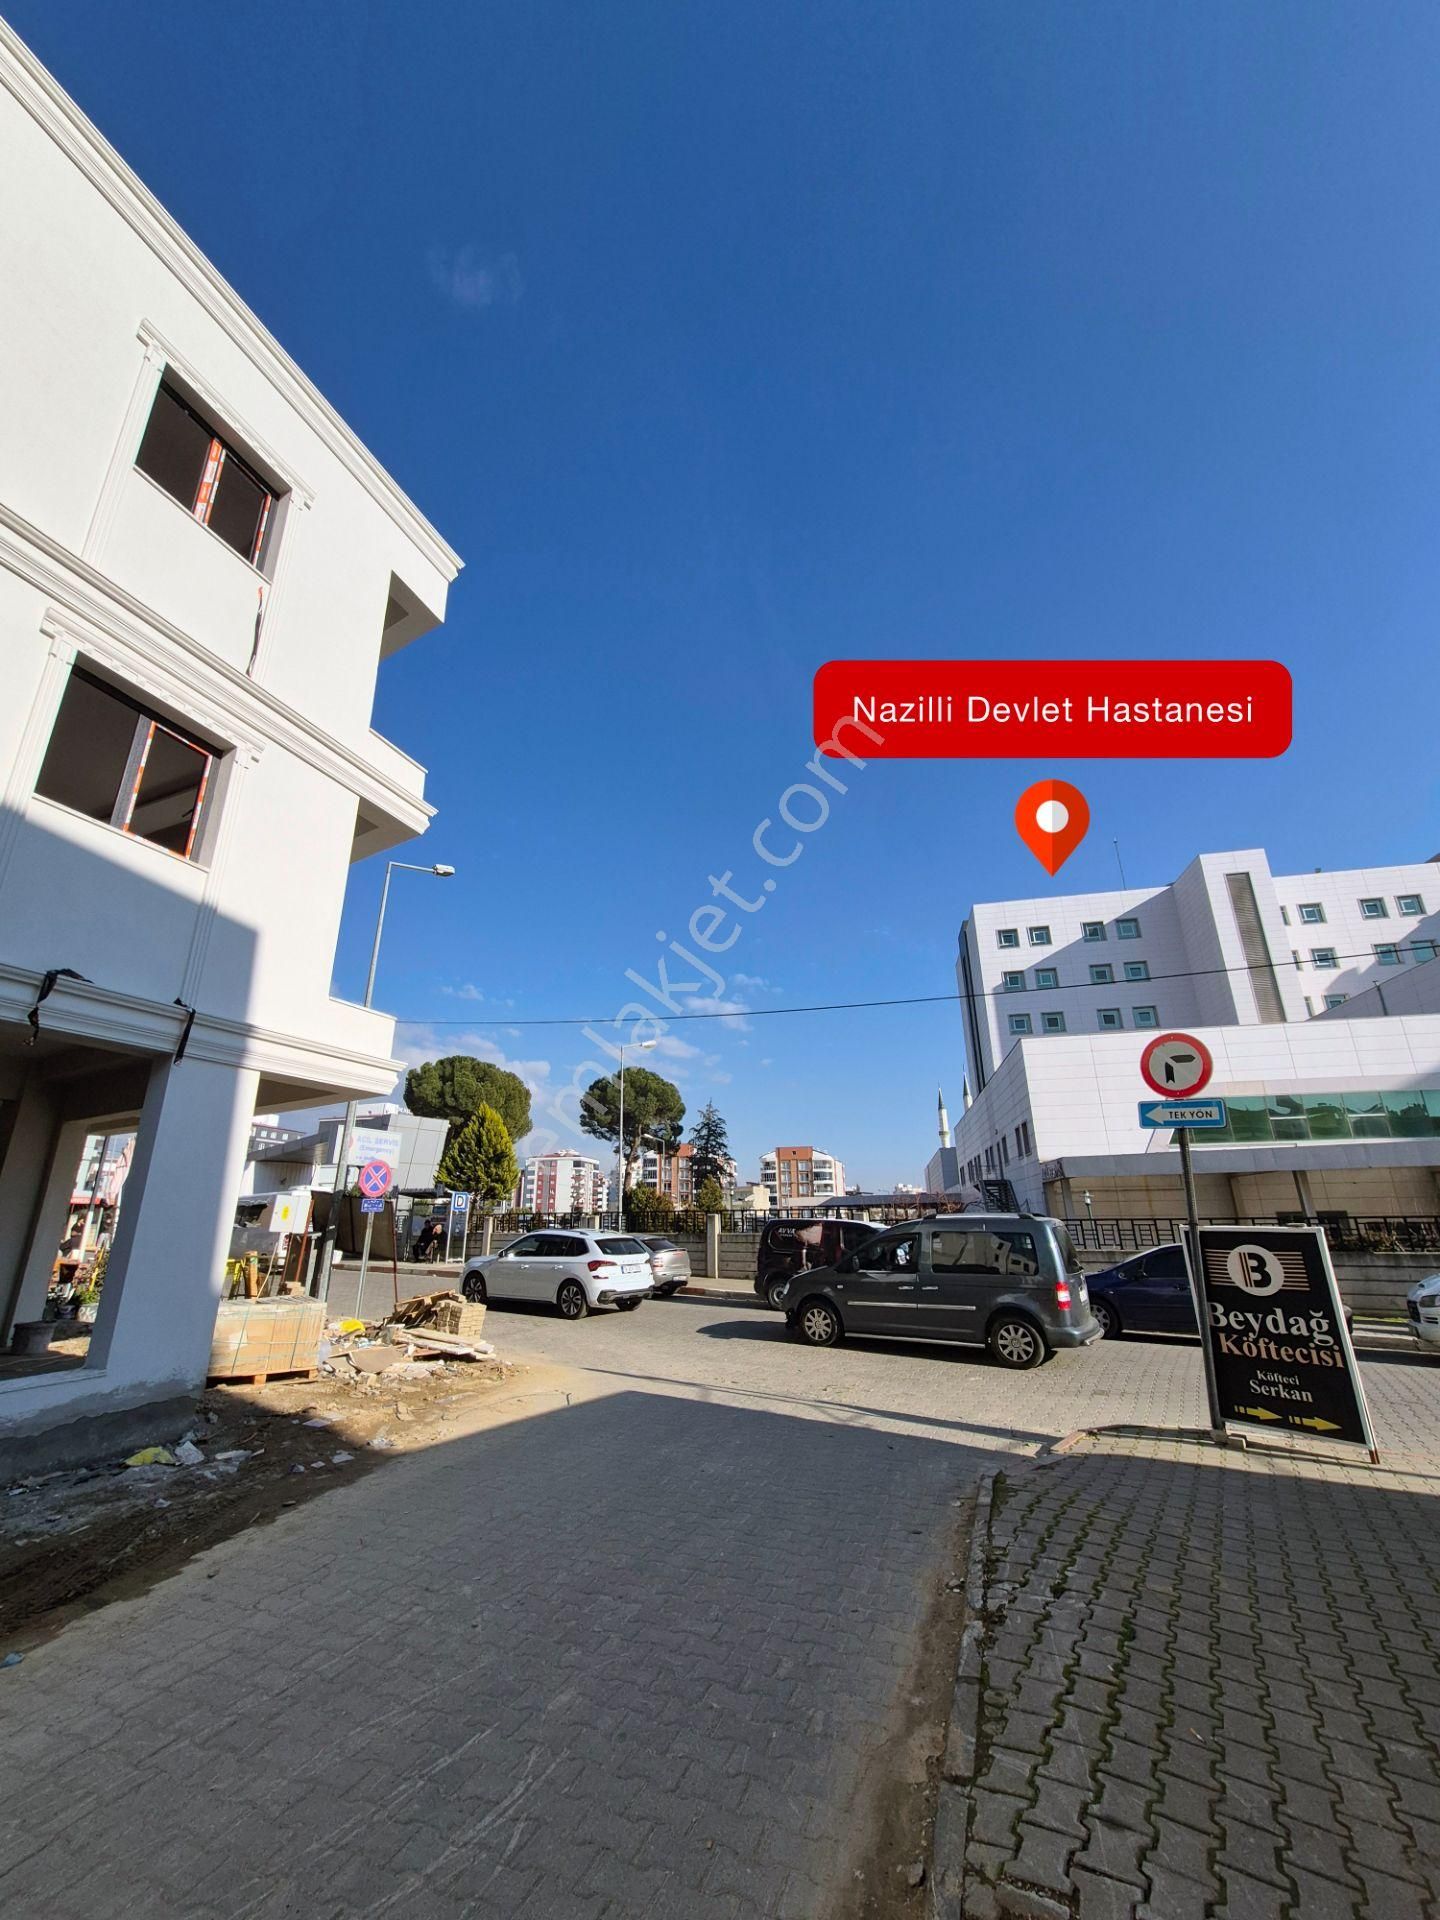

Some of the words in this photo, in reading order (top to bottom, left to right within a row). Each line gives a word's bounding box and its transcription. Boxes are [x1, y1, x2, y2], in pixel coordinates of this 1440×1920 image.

[1168, 1110, 1187, 1119] TEK
[1189, 1108, 1213, 1119] YÖN
[455, 1194, 466, 1208] D
[1207, 1302, 1335, 1347] Beydağ
[1218, 1332, 1345, 1369] Köftecisi
[1256, 1370, 1300, 1386] Köfteci
[1249, 1379, 1313, 1403] Serkan
